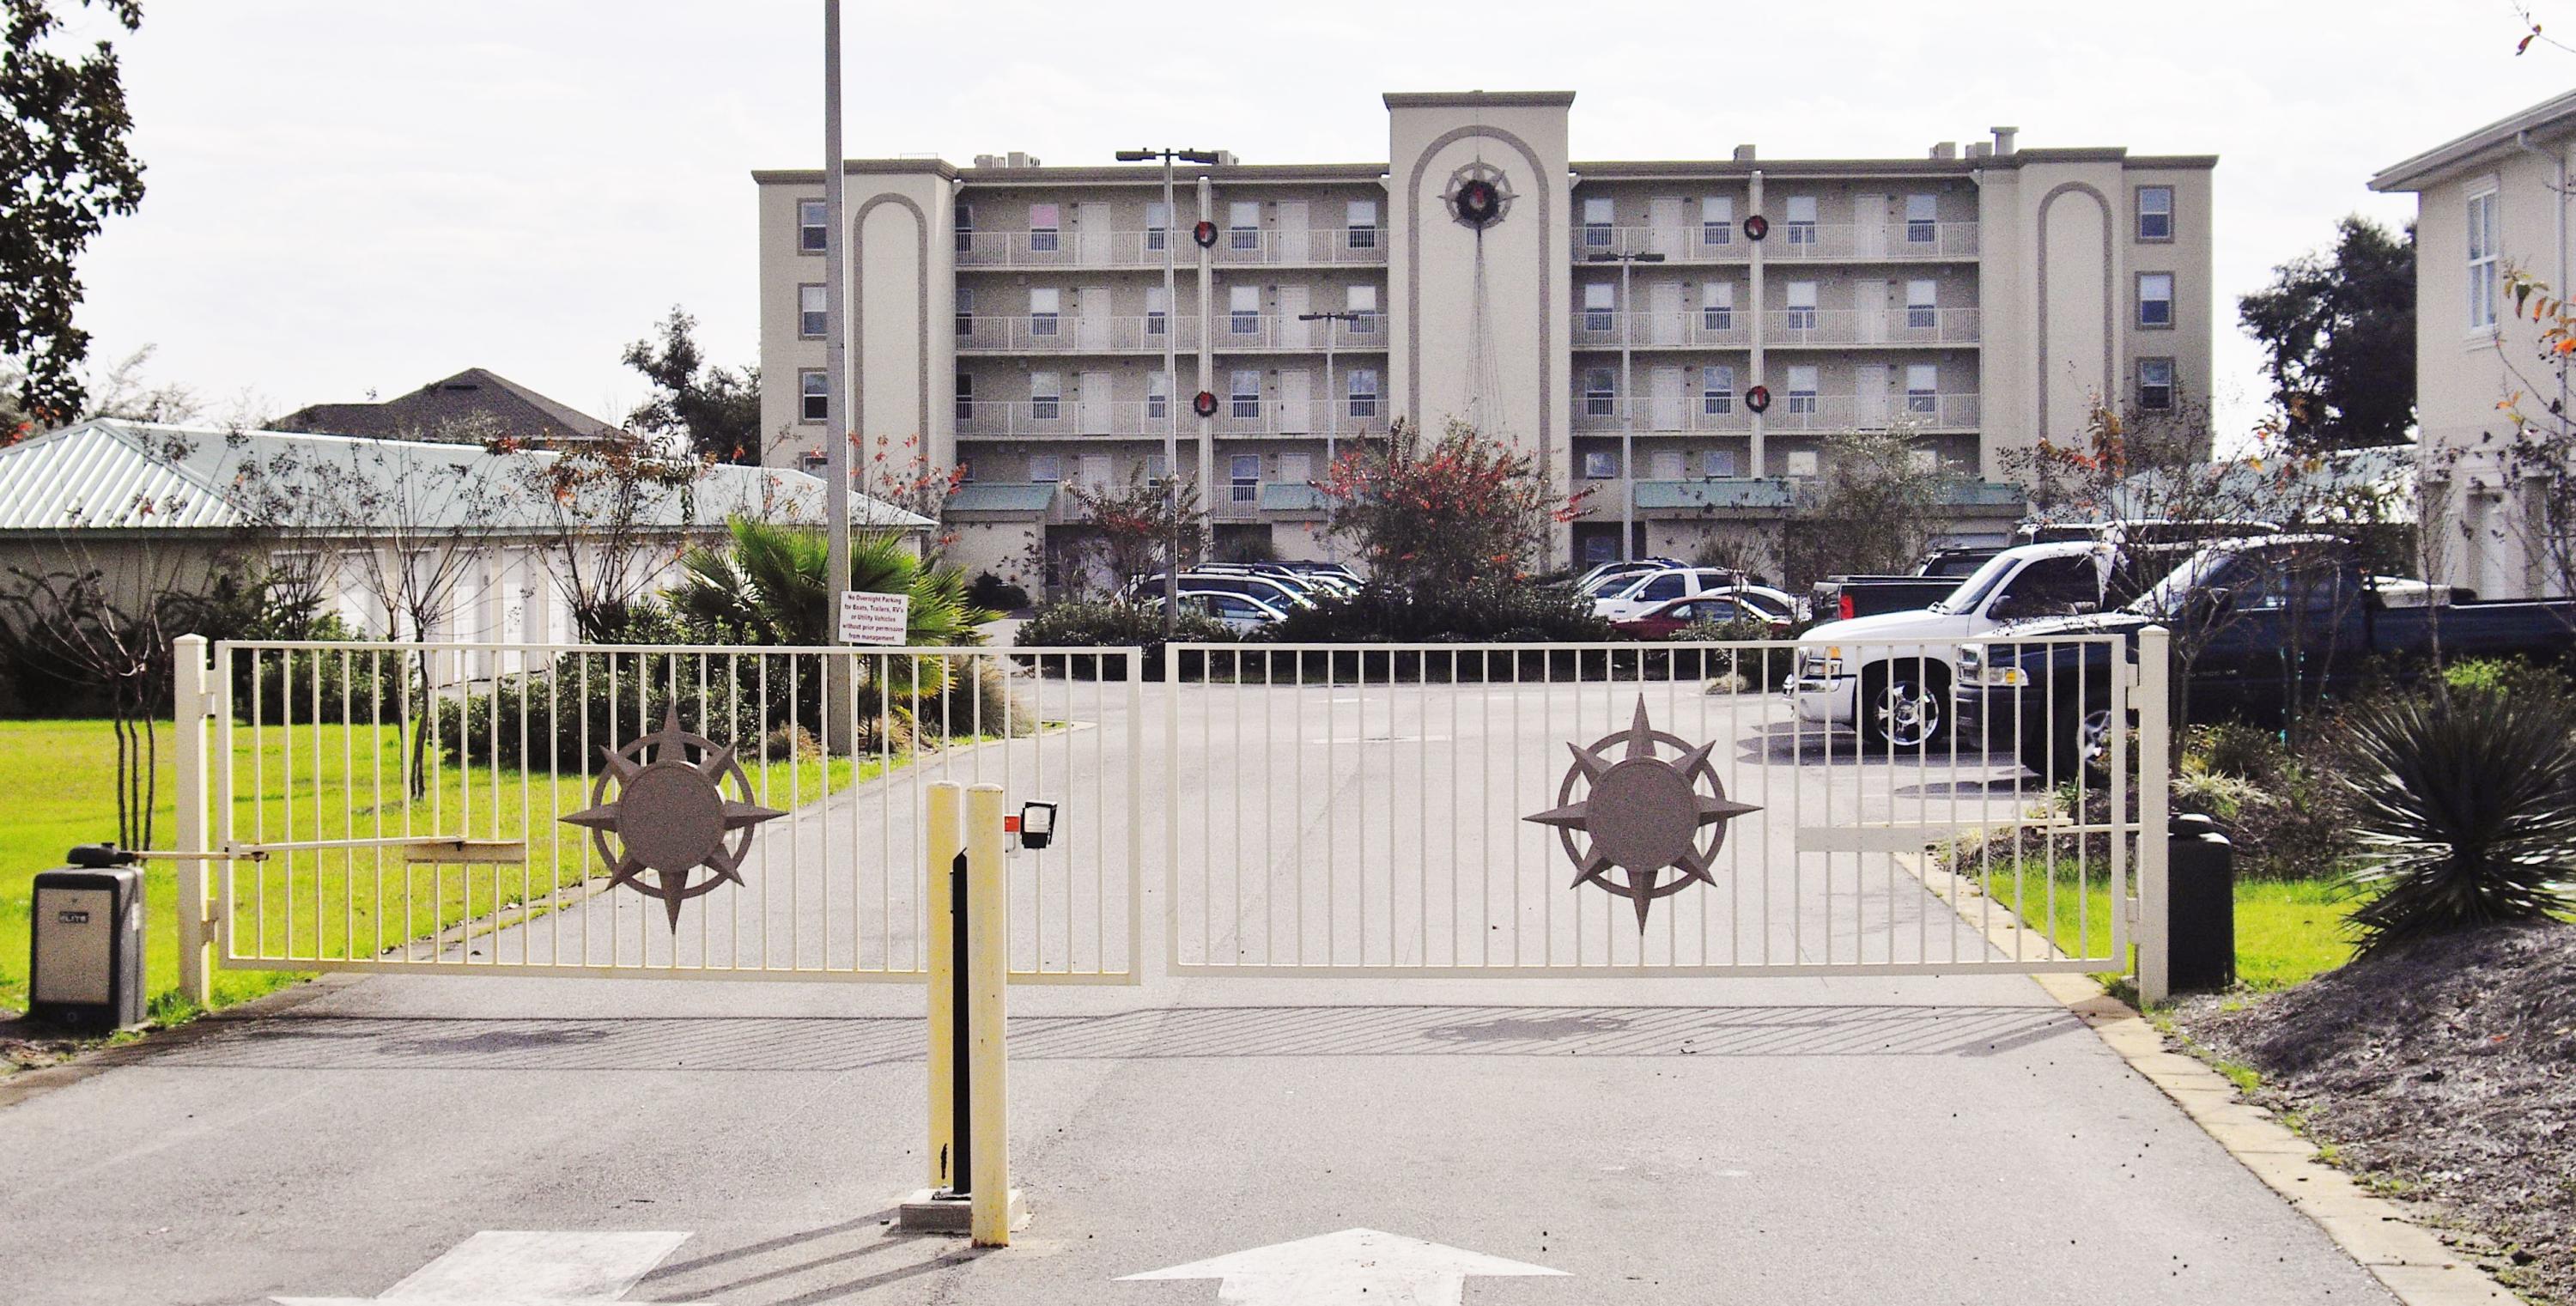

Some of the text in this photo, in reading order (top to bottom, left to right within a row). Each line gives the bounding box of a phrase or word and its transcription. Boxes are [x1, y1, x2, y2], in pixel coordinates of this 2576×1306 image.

[856, 594, 881, 603] Overnight
[882, 596, 902, 604] Parking
[870, 604, 891, 613] Trailers,
